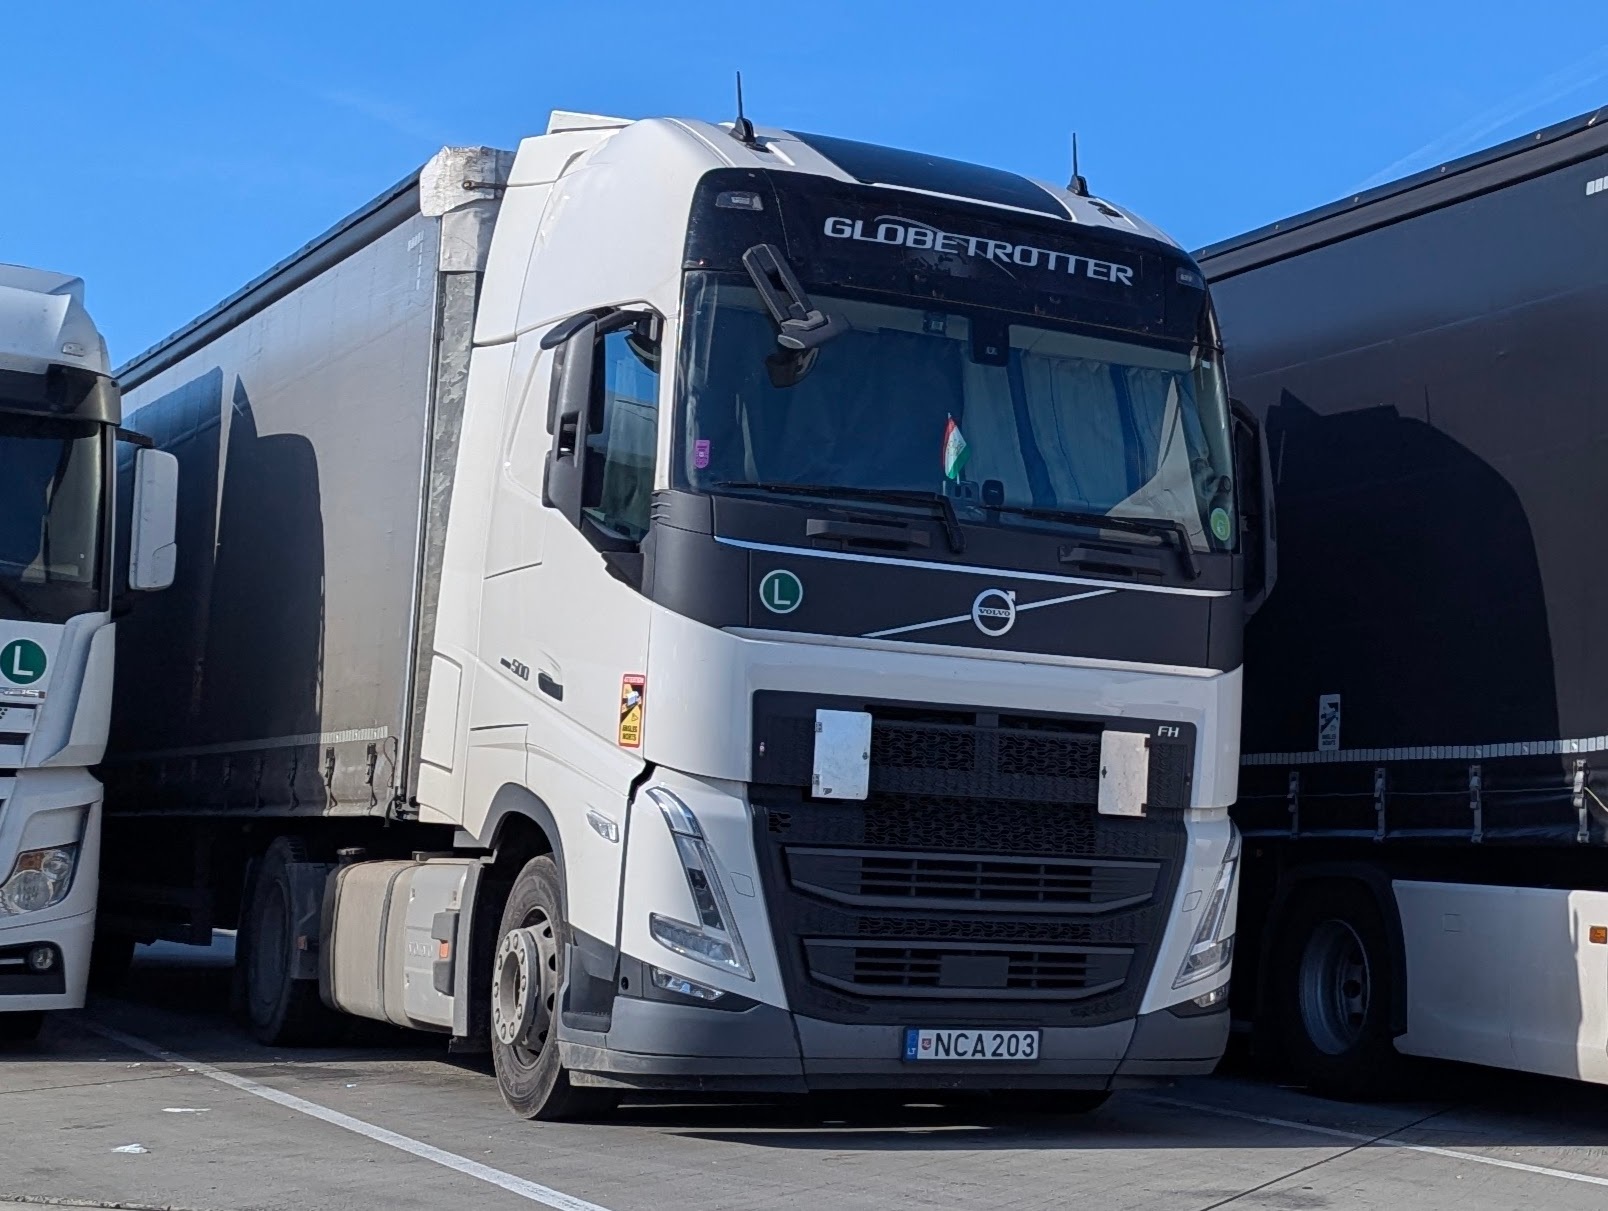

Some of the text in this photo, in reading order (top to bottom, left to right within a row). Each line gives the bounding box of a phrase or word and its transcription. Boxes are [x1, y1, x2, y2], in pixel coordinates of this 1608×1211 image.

[823, 216, 1134, 287] GLOBETROTTER
[773, 578, 791, 605] L
[979, 608, 1011, 617] VOLVO
[12, 645, 34, 676] L
[510, 658, 530, 682] 500
[1157, 725, 1180, 738] FH
[907, 1047, 917, 1055] LT
